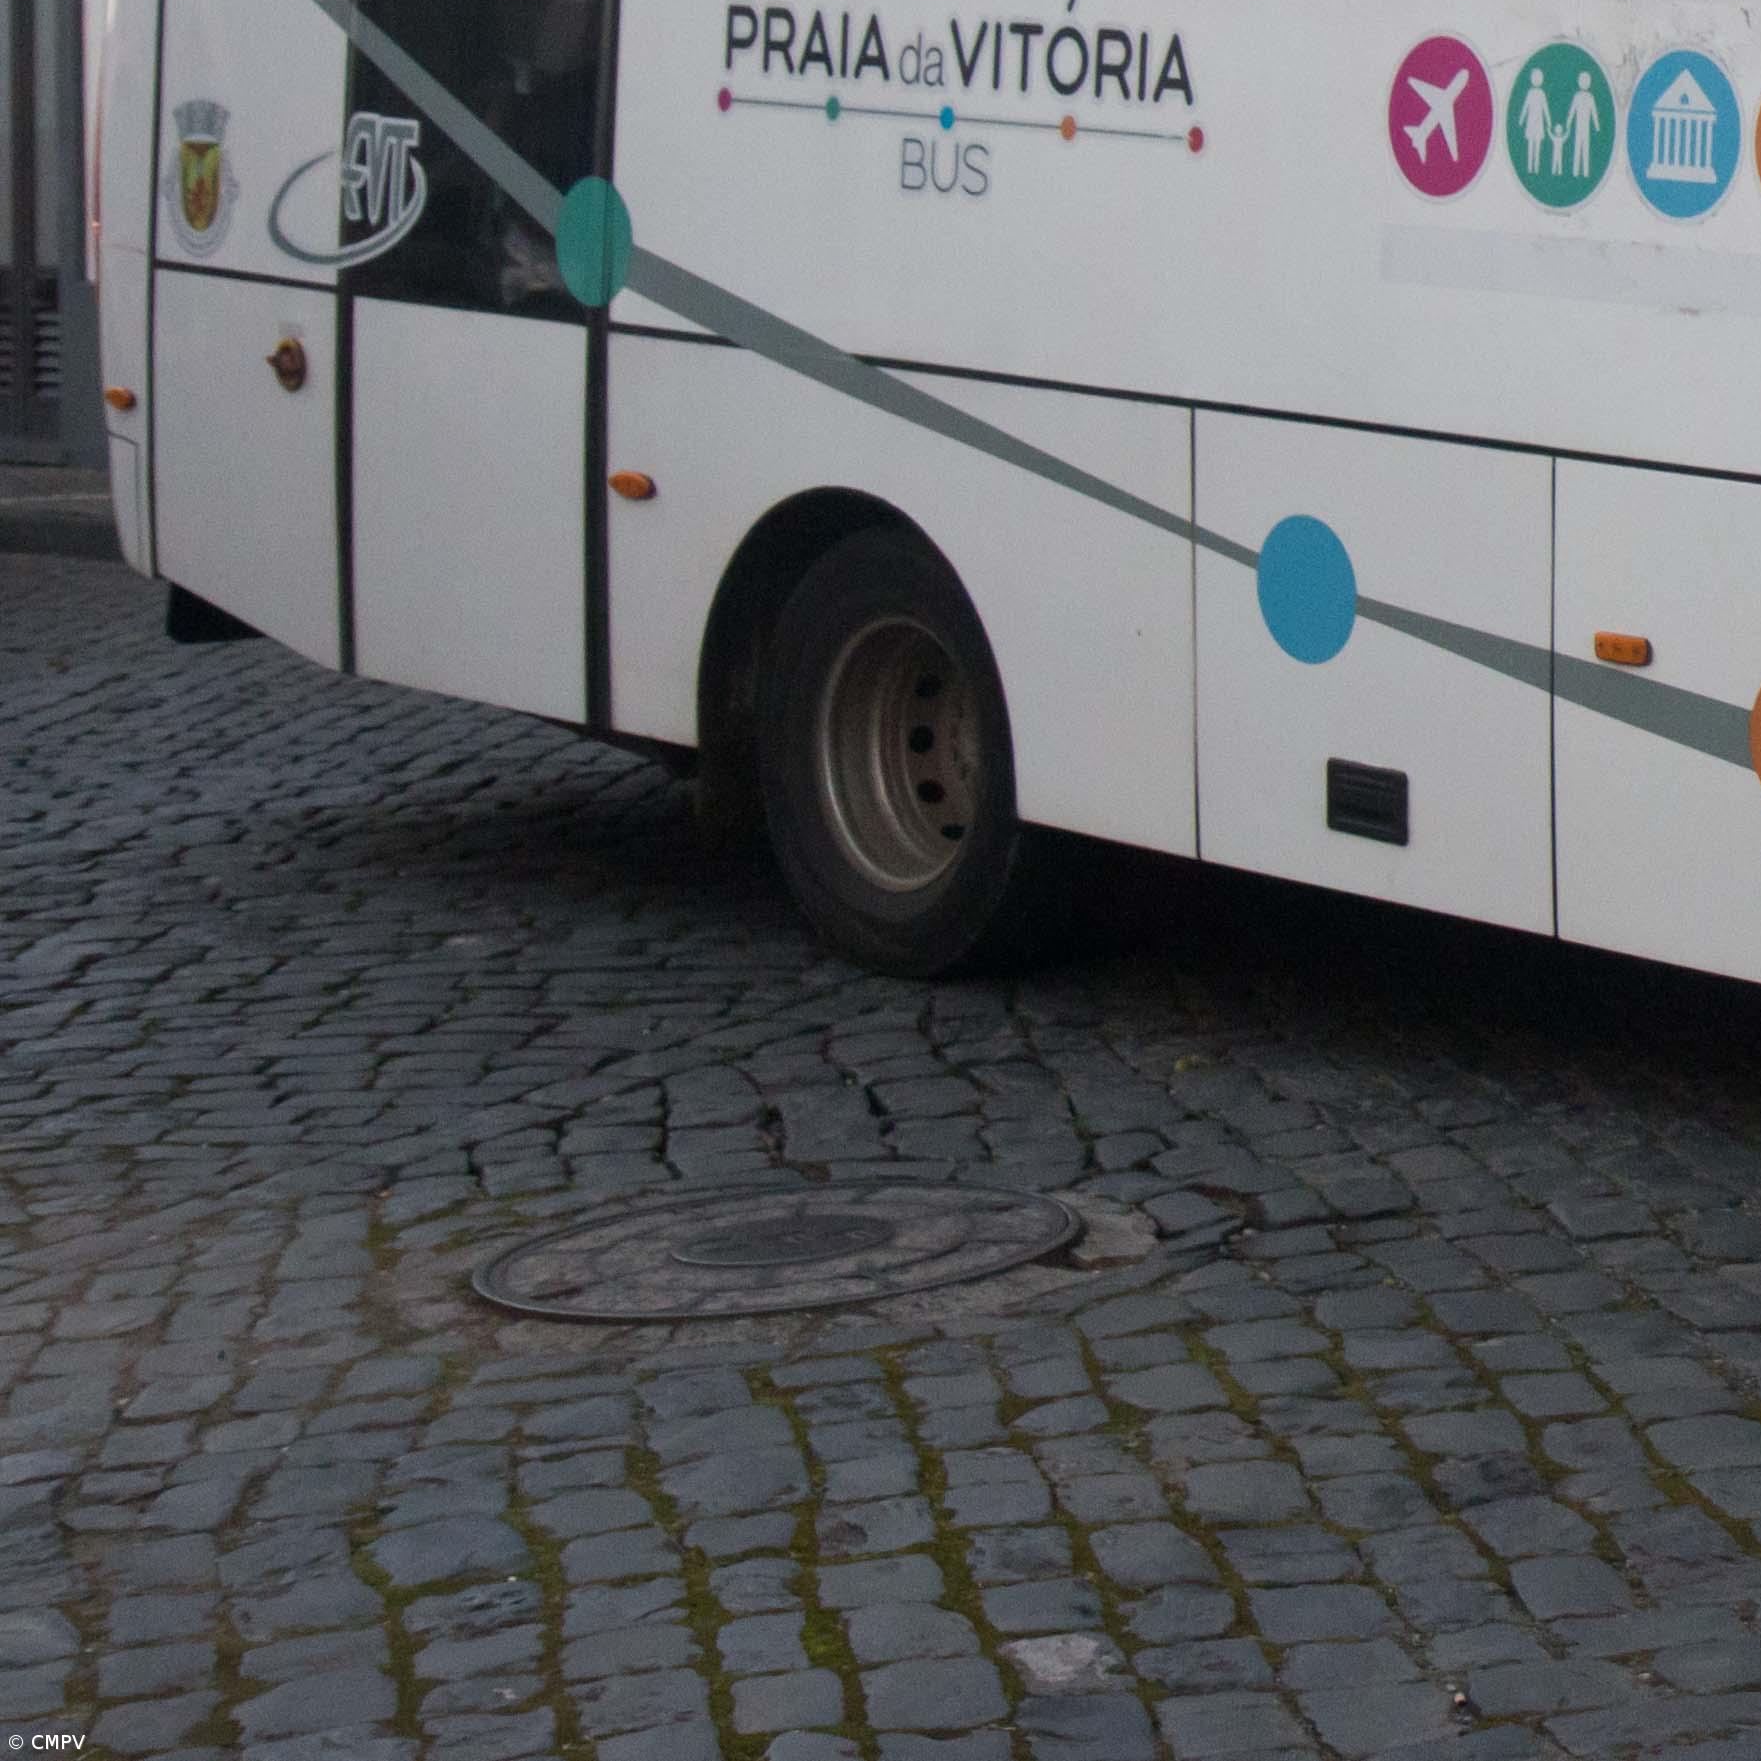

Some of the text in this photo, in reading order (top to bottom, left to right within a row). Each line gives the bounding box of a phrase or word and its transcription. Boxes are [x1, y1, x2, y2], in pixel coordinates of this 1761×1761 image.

[726, 3, 891, 82] PRAIA
[899, 32, 945, 88] da
[901, 137, 990, 197] BUS
